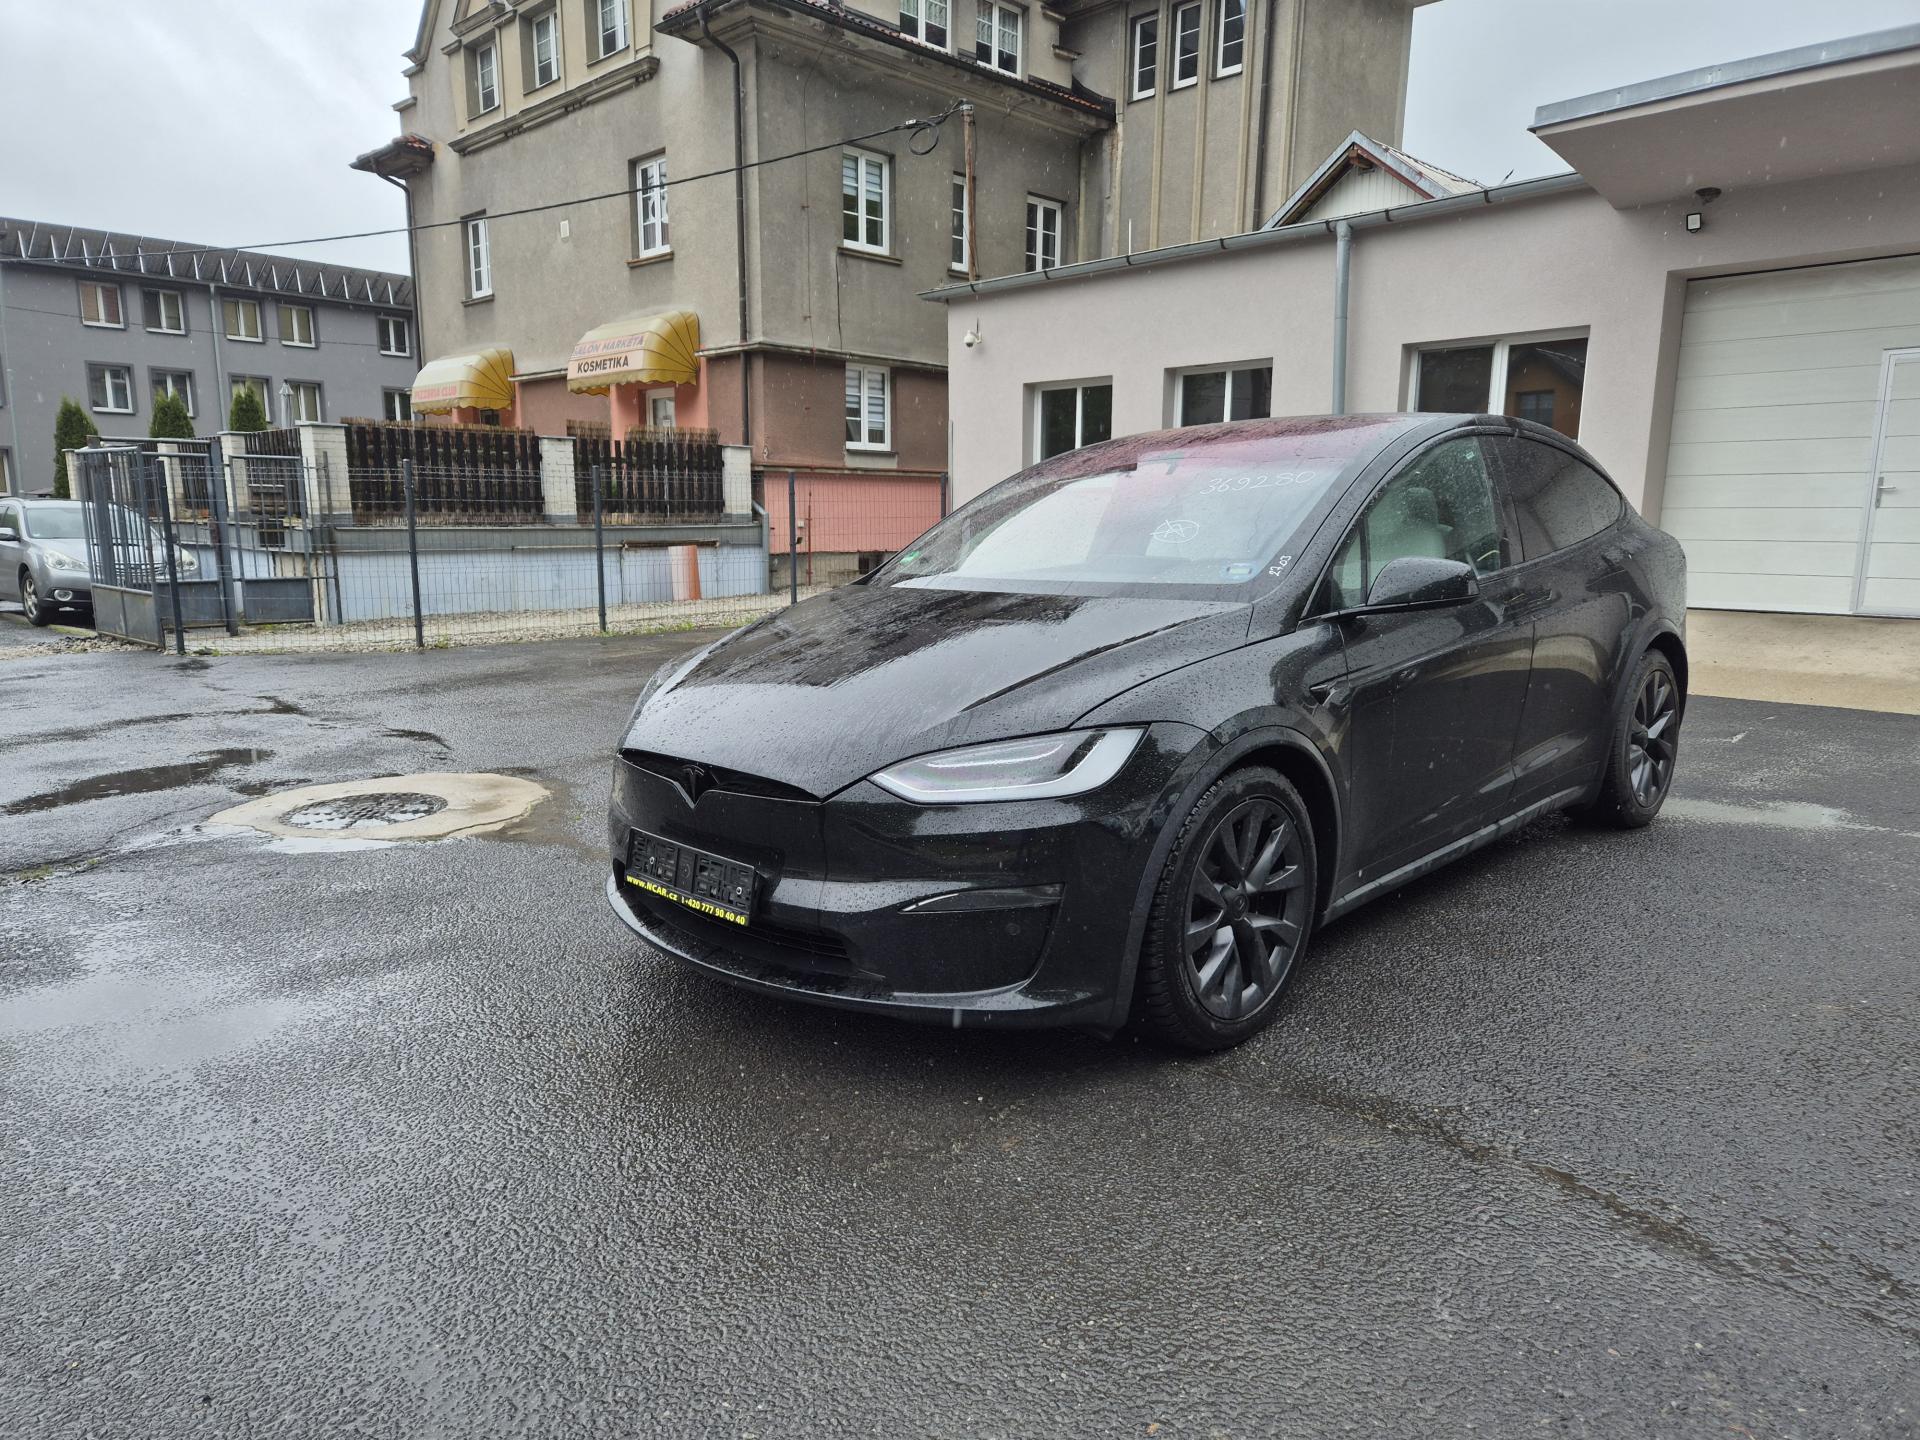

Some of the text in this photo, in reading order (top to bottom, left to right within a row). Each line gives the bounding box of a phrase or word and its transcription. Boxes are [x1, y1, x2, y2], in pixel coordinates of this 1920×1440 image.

[577, 355, 629, 373] KOSMETIKA
[626, 874, 678, 901] www.NCAR.cz
[701, 902, 714, 914] 777
[715, 907, 725, 918] 90
[725, 911, 735, 922] 40
[735, 915, 746, 925] 40
